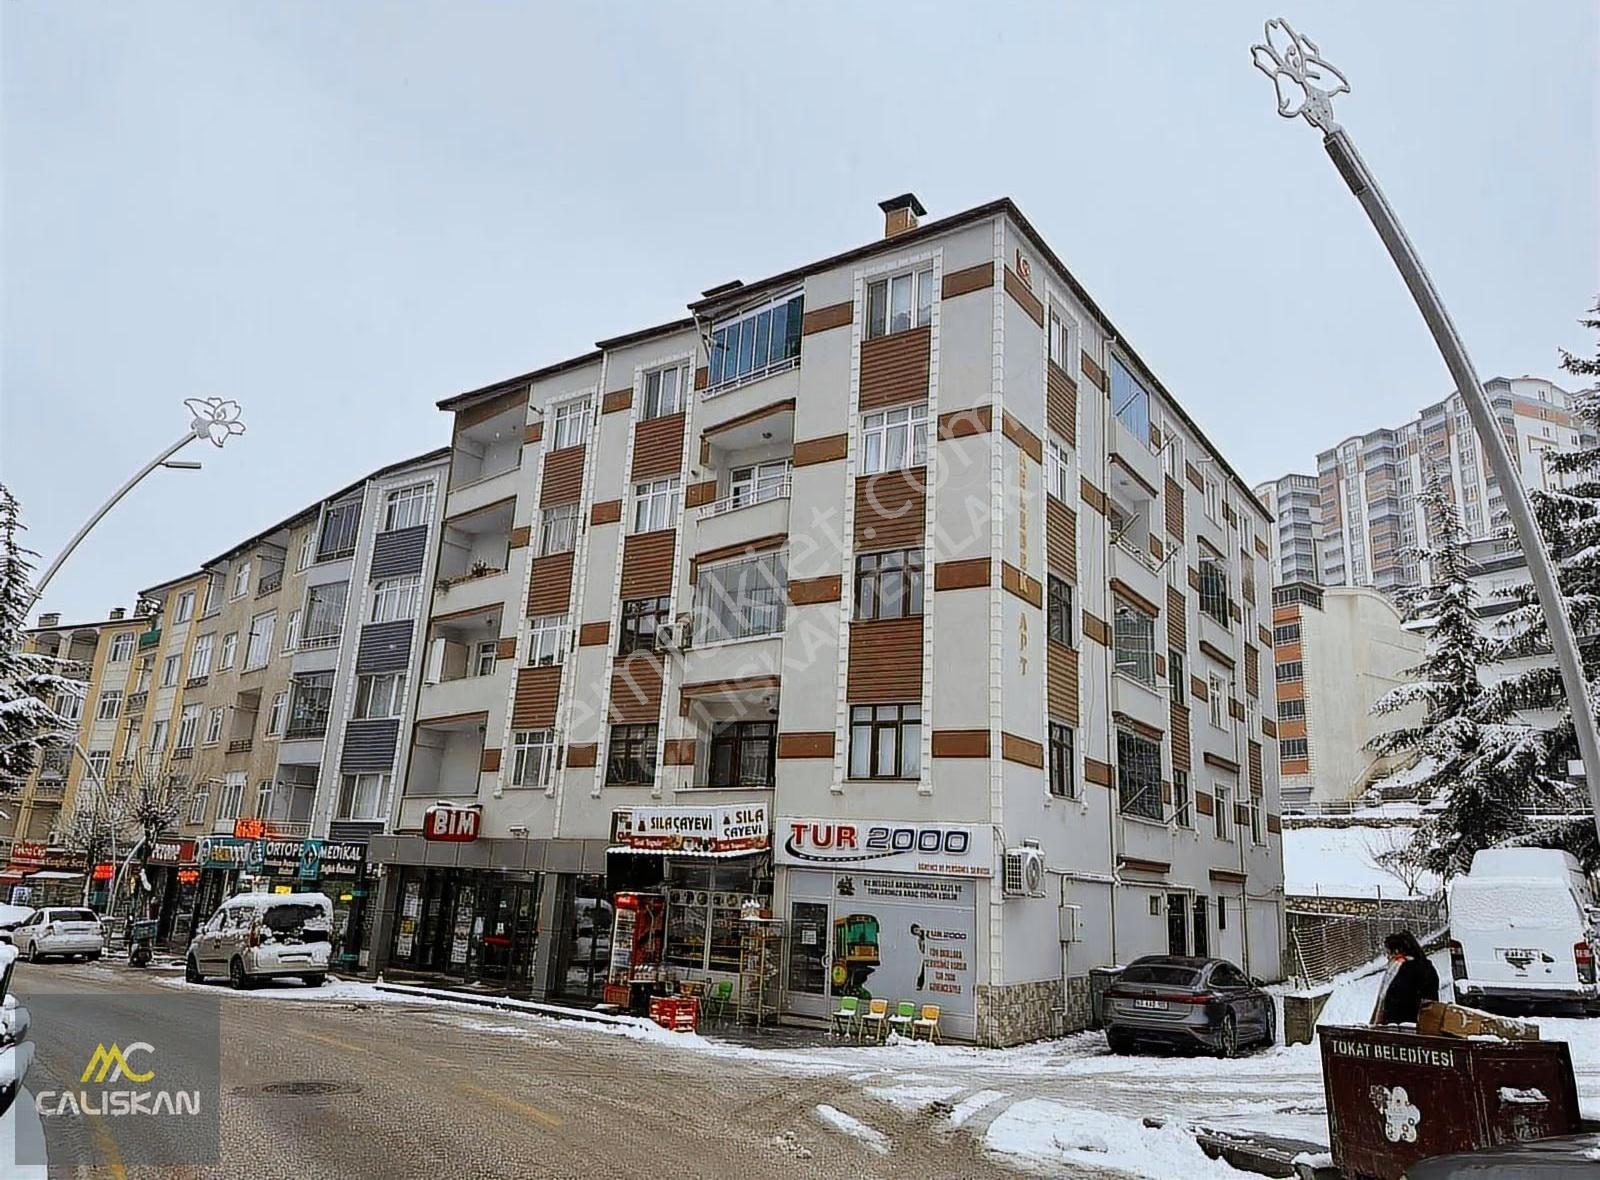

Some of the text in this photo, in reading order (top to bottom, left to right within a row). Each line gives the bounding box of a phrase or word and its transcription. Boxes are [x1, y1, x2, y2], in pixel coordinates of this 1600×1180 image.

[433, 809, 475, 835] BİM
[650, 816, 672, 830] SILA
[673, 814, 712, 833] ÇAYEVİ
[735, 808, 764, 824] SILA
[723, 825, 762, 838] ÇAYEVİ
[790, 823, 970, 854] TUR 2000
[319, 842, 362, 861] MEDİKAL
[1331, 1040, 1454, 1067] TOKAT BELEDİYESİ
